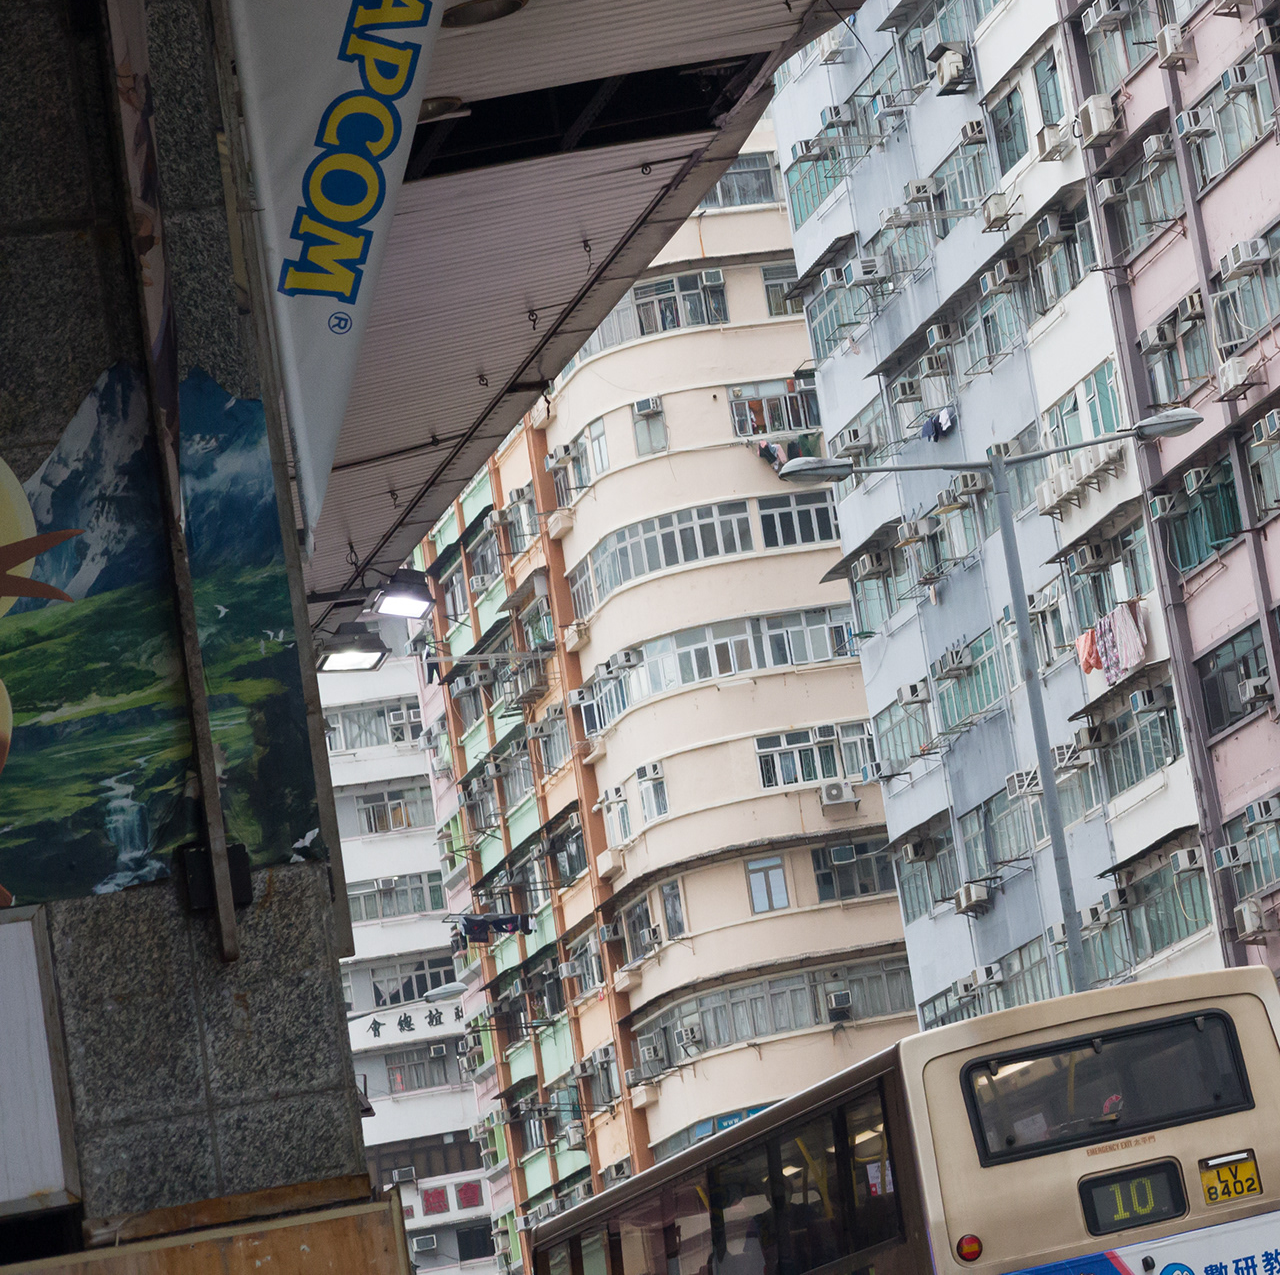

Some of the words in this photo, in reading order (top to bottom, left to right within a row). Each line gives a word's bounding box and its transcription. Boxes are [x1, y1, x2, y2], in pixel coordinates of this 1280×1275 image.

[1086, 1143, 1120, 1156] EMERGENCY
[1120, 1140, 1134, 1151] EXIT
[1134, 1134, 1156, 1146] 太平門
[1216, 1165, 1239, 1183] LV
[1109, 1177, 1155, 1221] 10
[1207, 1177, 1257, 1202] 8402
